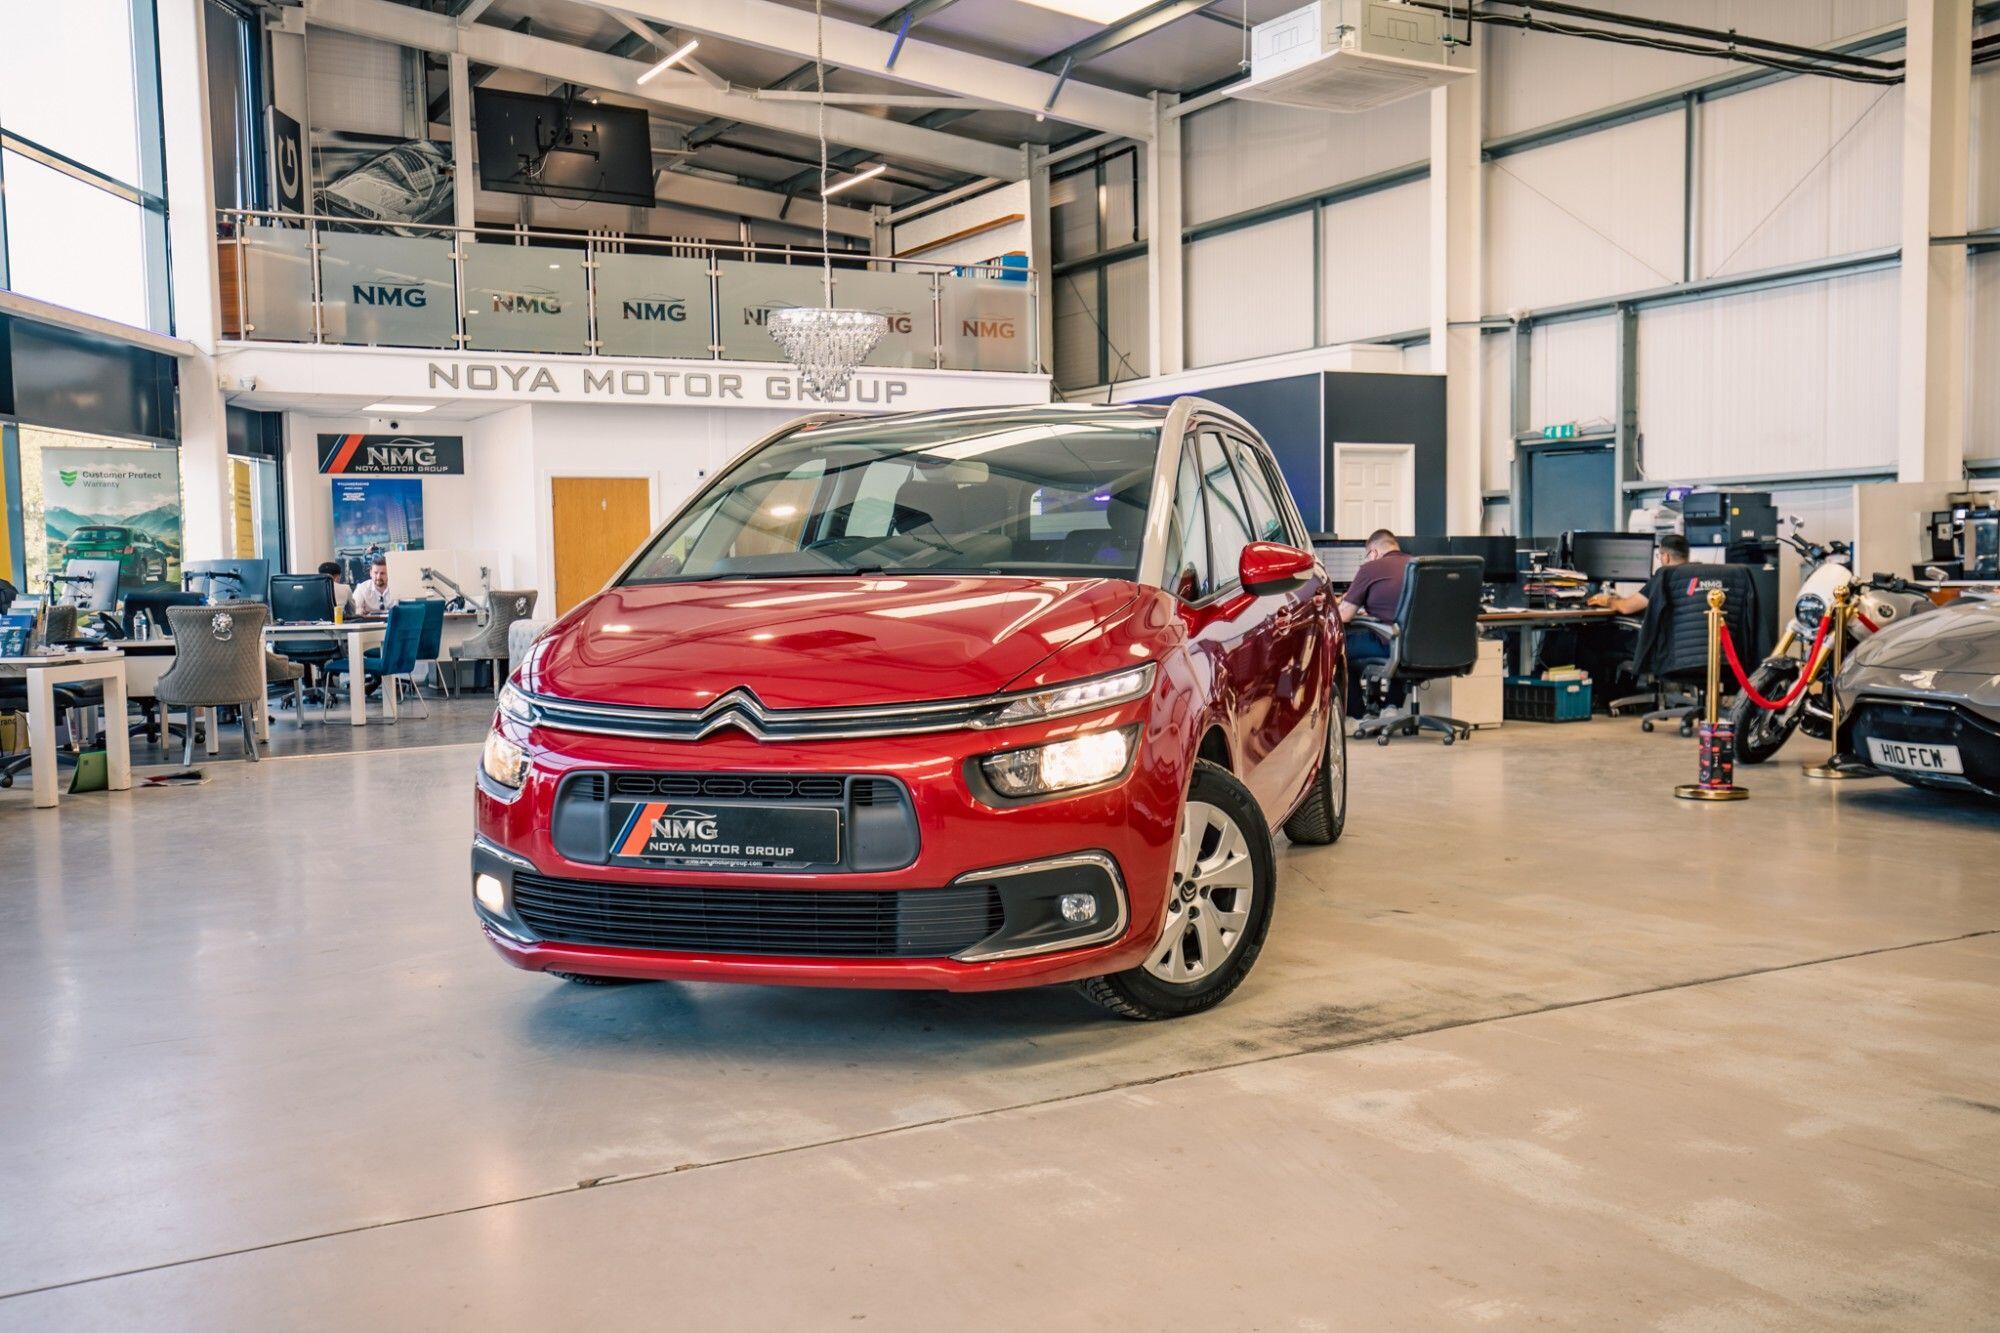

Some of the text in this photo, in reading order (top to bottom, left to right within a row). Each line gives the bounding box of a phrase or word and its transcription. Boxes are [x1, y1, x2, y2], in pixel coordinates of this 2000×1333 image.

[353, 284, 427, 308] NMG
[492, 293, 562, 315] NMG
[623, 301, 687, 322] NMG
[962, 320, 1016, 339] NMG
[428, 362, 560, 393] NOYA
[583, 368, 743, 399] MOTOR
[366, 446, 437, 466] NMG
[82, 470, 162, 480] Customer Protect
[382, 465, 415, 473] MOTOR
[417, 465, 449, 473] GROUP
[83, 480, 120, 489] Warranty
[1907, 747, 1944, 768] FCW
[650, 818, 718, 840] NMG
[649, 842, 794, 857] NOYA MOTOR GROUP
